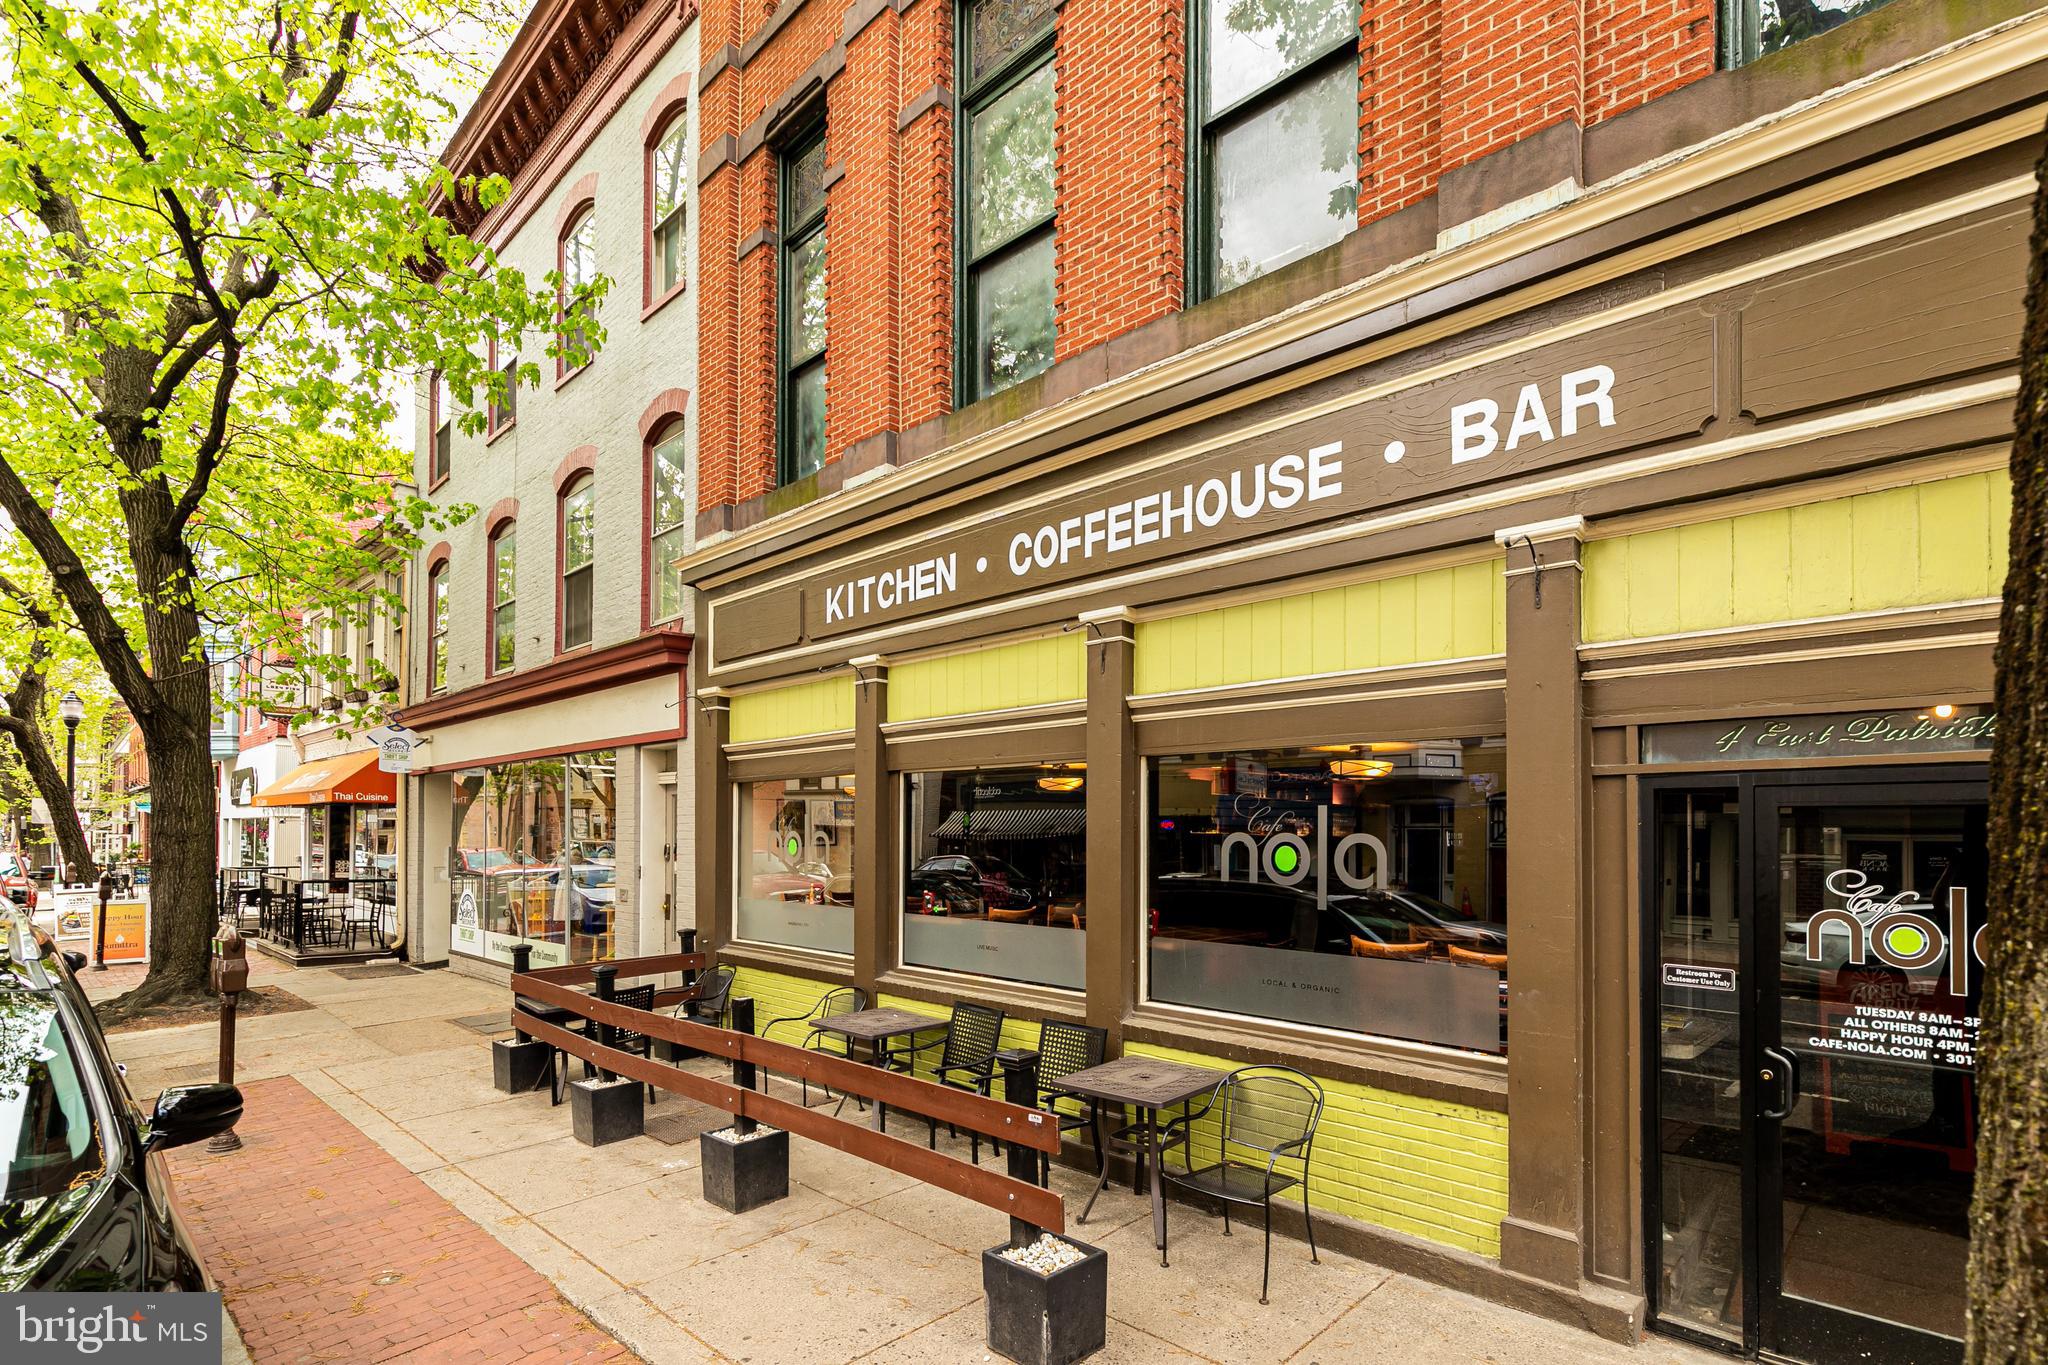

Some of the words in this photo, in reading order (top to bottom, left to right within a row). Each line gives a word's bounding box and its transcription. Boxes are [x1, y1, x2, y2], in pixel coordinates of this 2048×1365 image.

[824, 552, 957, 624] KITCHEN
[1007, 440, 1343, 576] COFFEEHOUSE
[1451, 365, 1616, 466] BAR
[1715, 724, 1747, 752] 4
[1756, 719, 1835, 747] East
[333, 791, 354, 801] Thai
[355, 791, 389, 802] Cuisine
[1234, 792, 1296, 846] Cafe
[1221, 804, 1388, 911] nola
[1825, 868, 1920, 927] Cafe
[1667, 975, 1700, 984] Customer
[1700, 978, 1714, 986] Use
[1714, 980, 1731, 989] Only
[1675, 968, 1709, 978] Restroom
[1709, 971, 1722, 979] For
[1262, 978, 1289, 988] LOCAL
[1300, 983, 1341, 994] ORGANIC
[1854, 1006, 1915, 1021] TUESDAY
[1844, 1017, 1869, 1028] ALL
[1871, 1020, 1926, 1034] OTHERS
[1808, 1036, 1927, 1060] CAFE-NOLA.COM
[1840, 1028, 1888, 1043] HAPPY
[1890, 1034, 1934, 1048] HOUR
